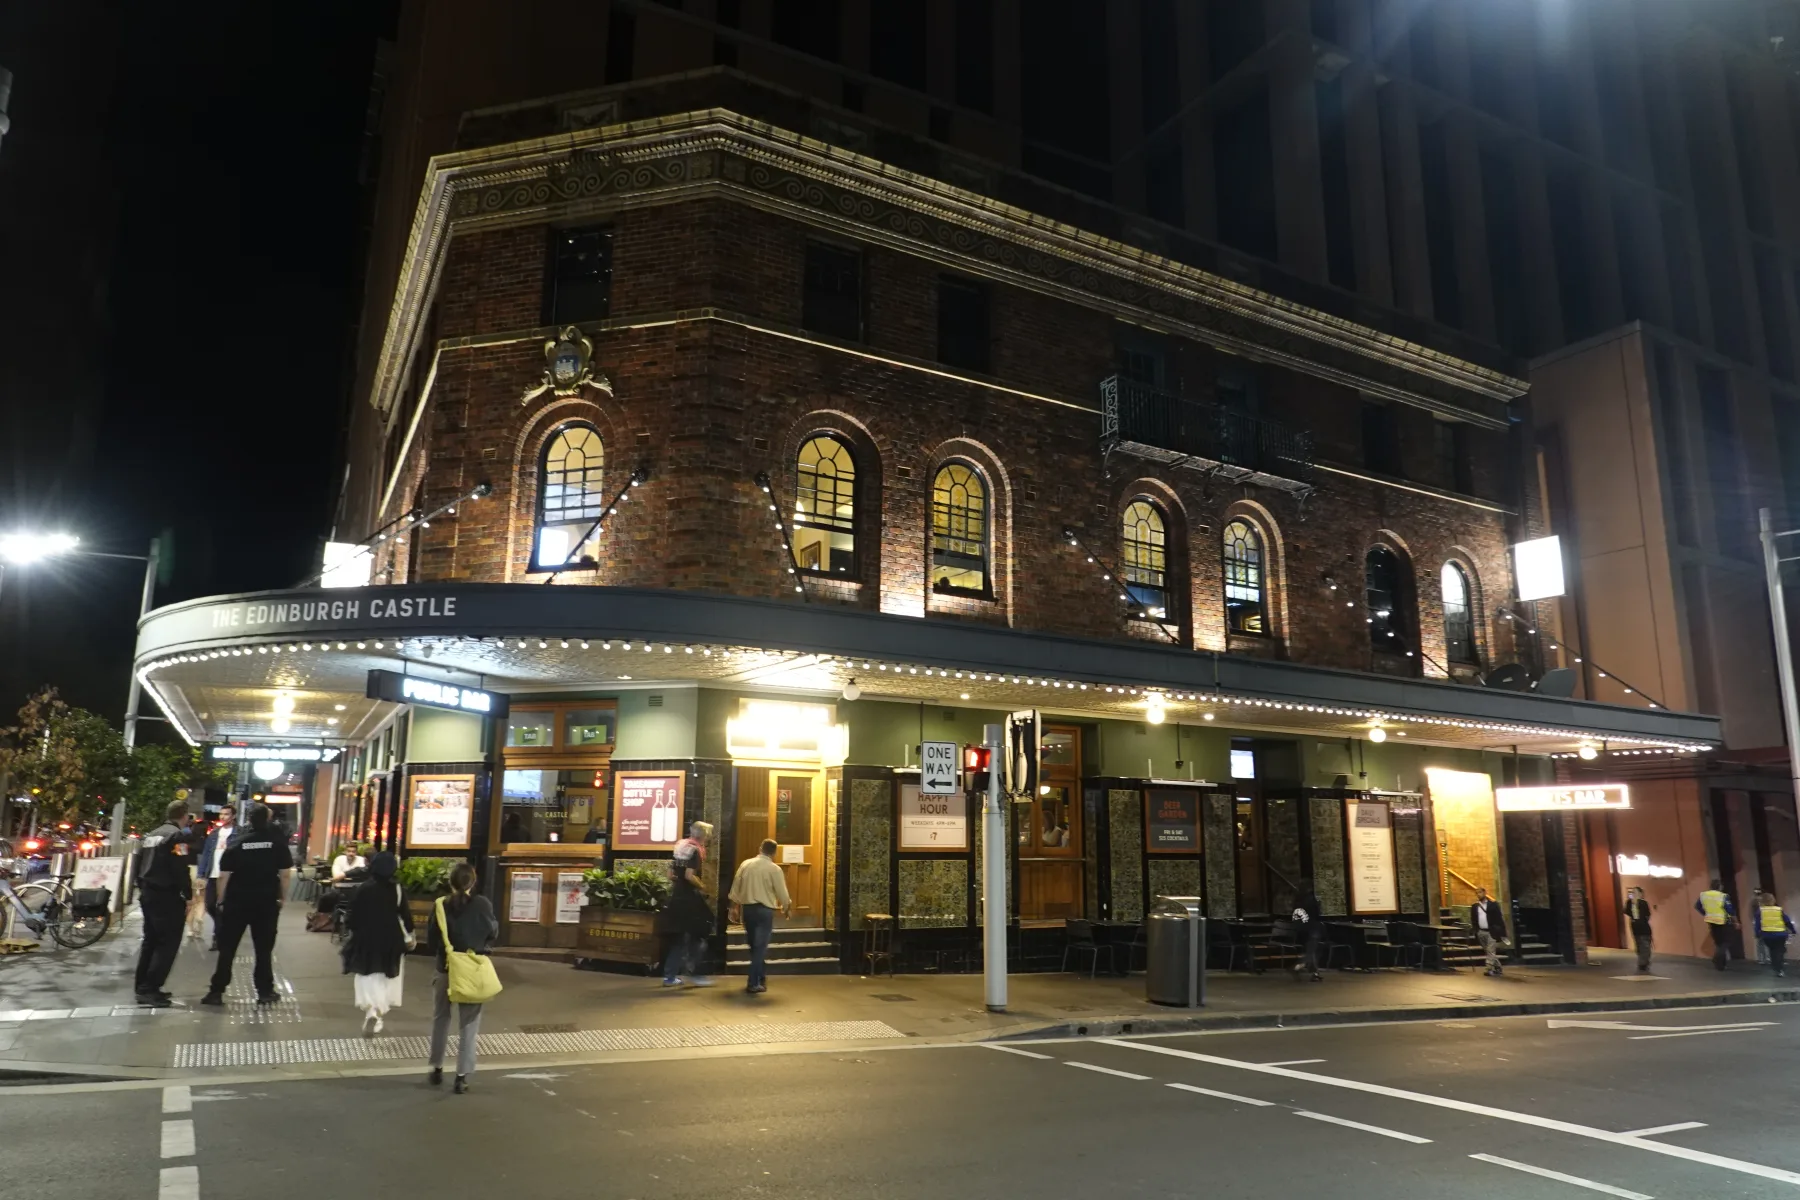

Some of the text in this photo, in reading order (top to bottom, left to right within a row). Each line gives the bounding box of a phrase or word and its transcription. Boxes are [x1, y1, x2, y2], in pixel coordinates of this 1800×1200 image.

[212, 597, 457, 628] THE EDINBURGH CASTLE
[927, 746, 951, 759] ONE
[926, 763, 953, 775] WAY
[623, 789, 653, 798] BOTTLE
[622, 798, 645, 807] SHOP
[919, 803, 948, 815] HOUR
[929, 831, 938, 841] $7
[241, 841, 273, 850] SECURITY
[79, 864, 119, 873] ANZAC
[589, 928, 641, 940] EDINBURGH
